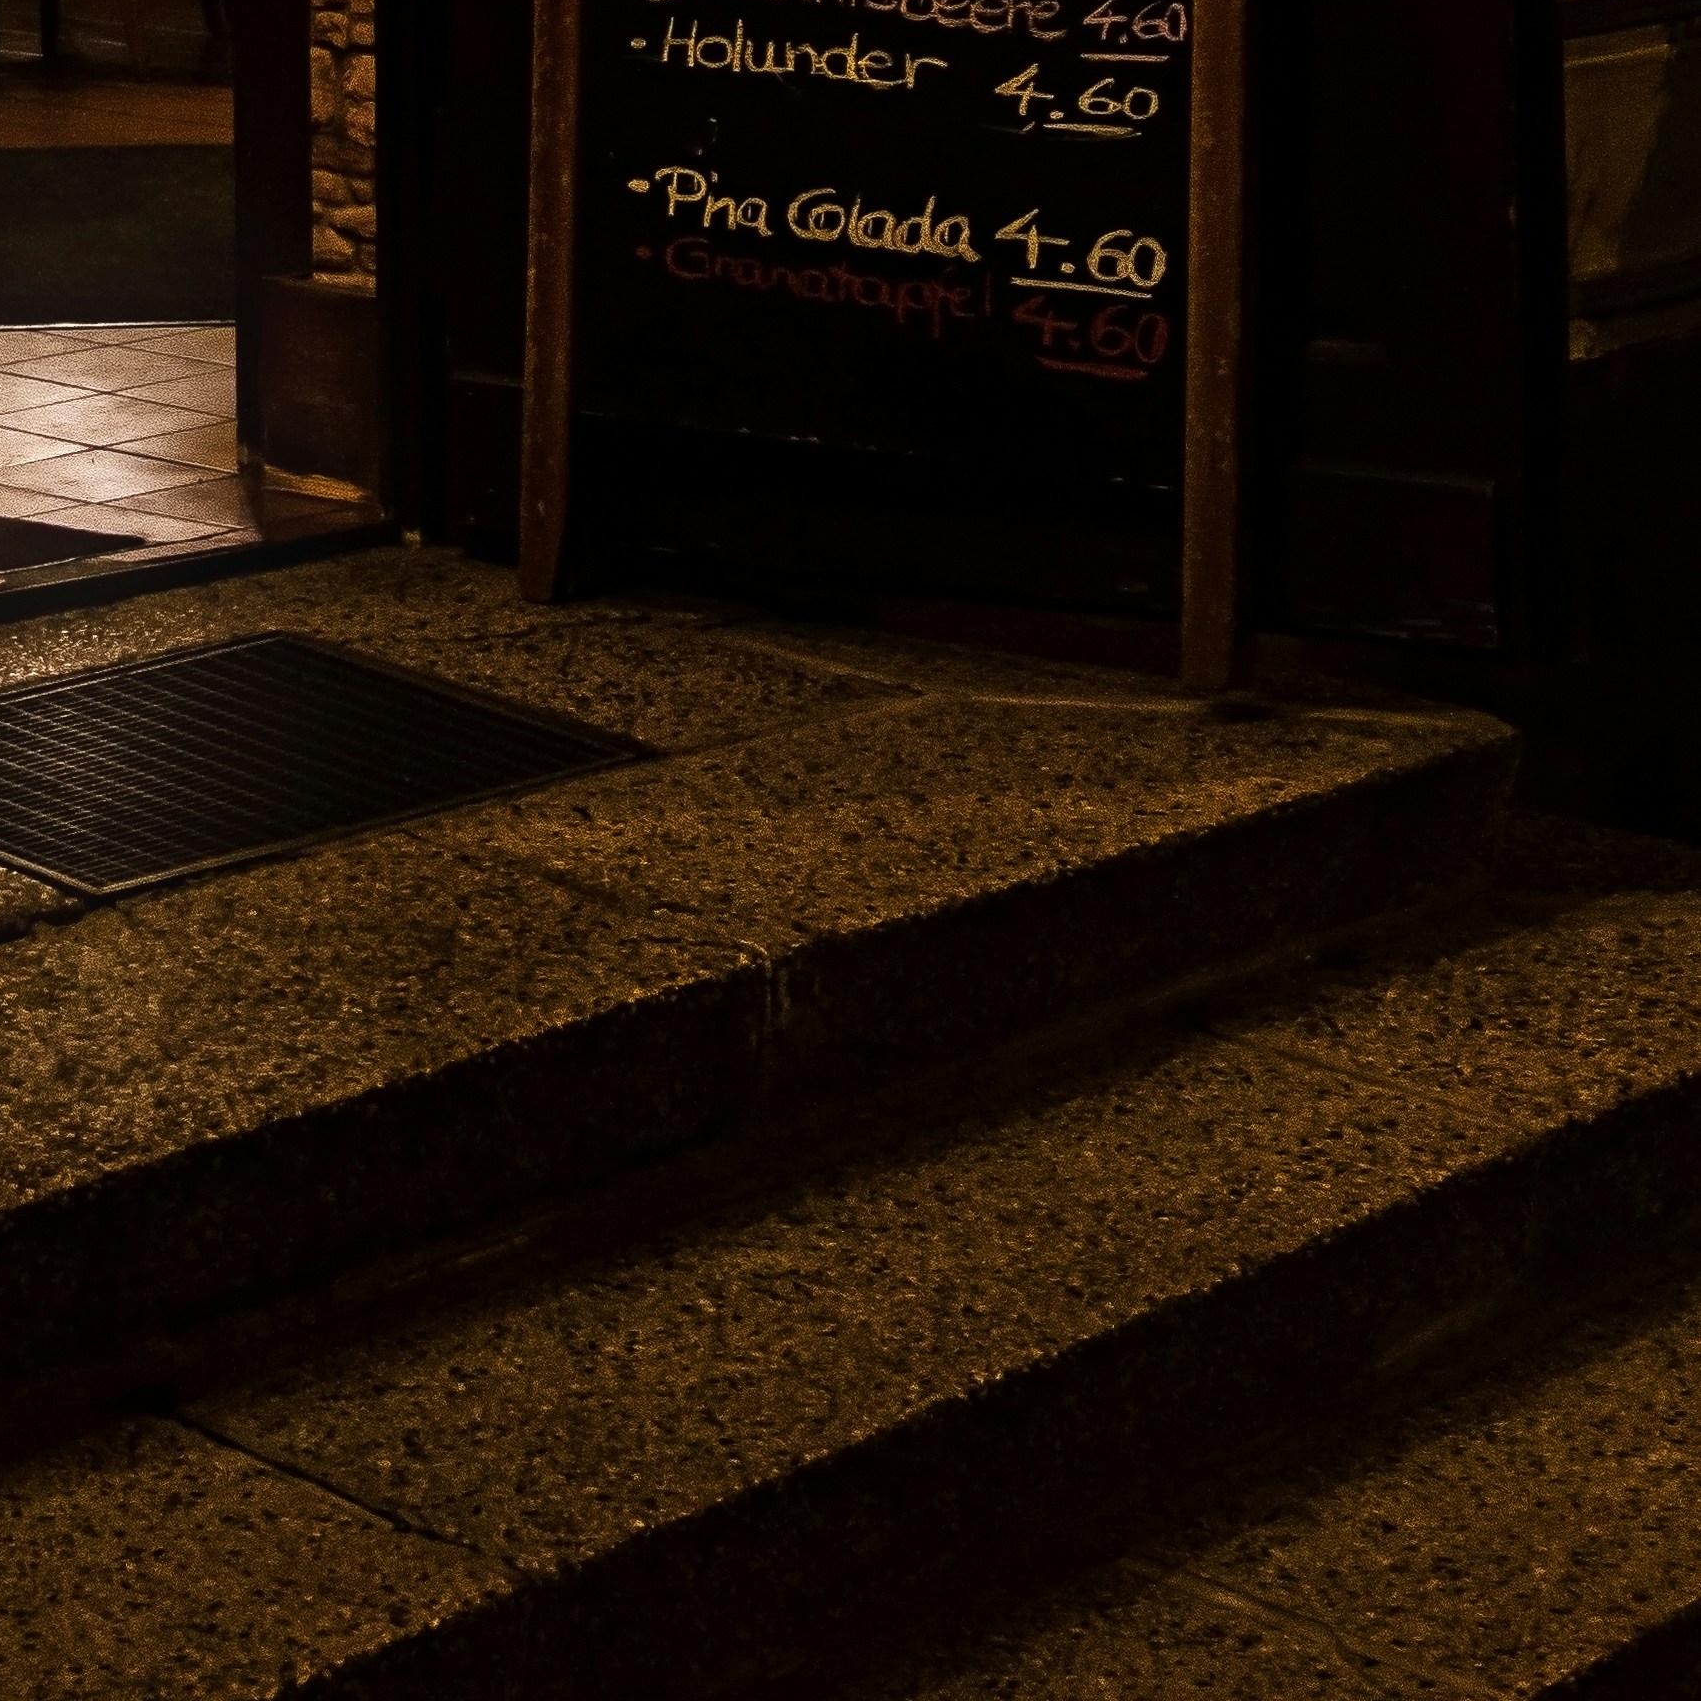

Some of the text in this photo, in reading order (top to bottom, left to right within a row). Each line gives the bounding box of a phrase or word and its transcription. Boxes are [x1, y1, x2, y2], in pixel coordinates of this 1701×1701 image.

[660, 17, 1160, 121] Holunder 4.60
[787, 188, 981, 263] Colada
[994, 208, 1167, 288] 4.60
[1013, 295, 1170, 364] 4.60
